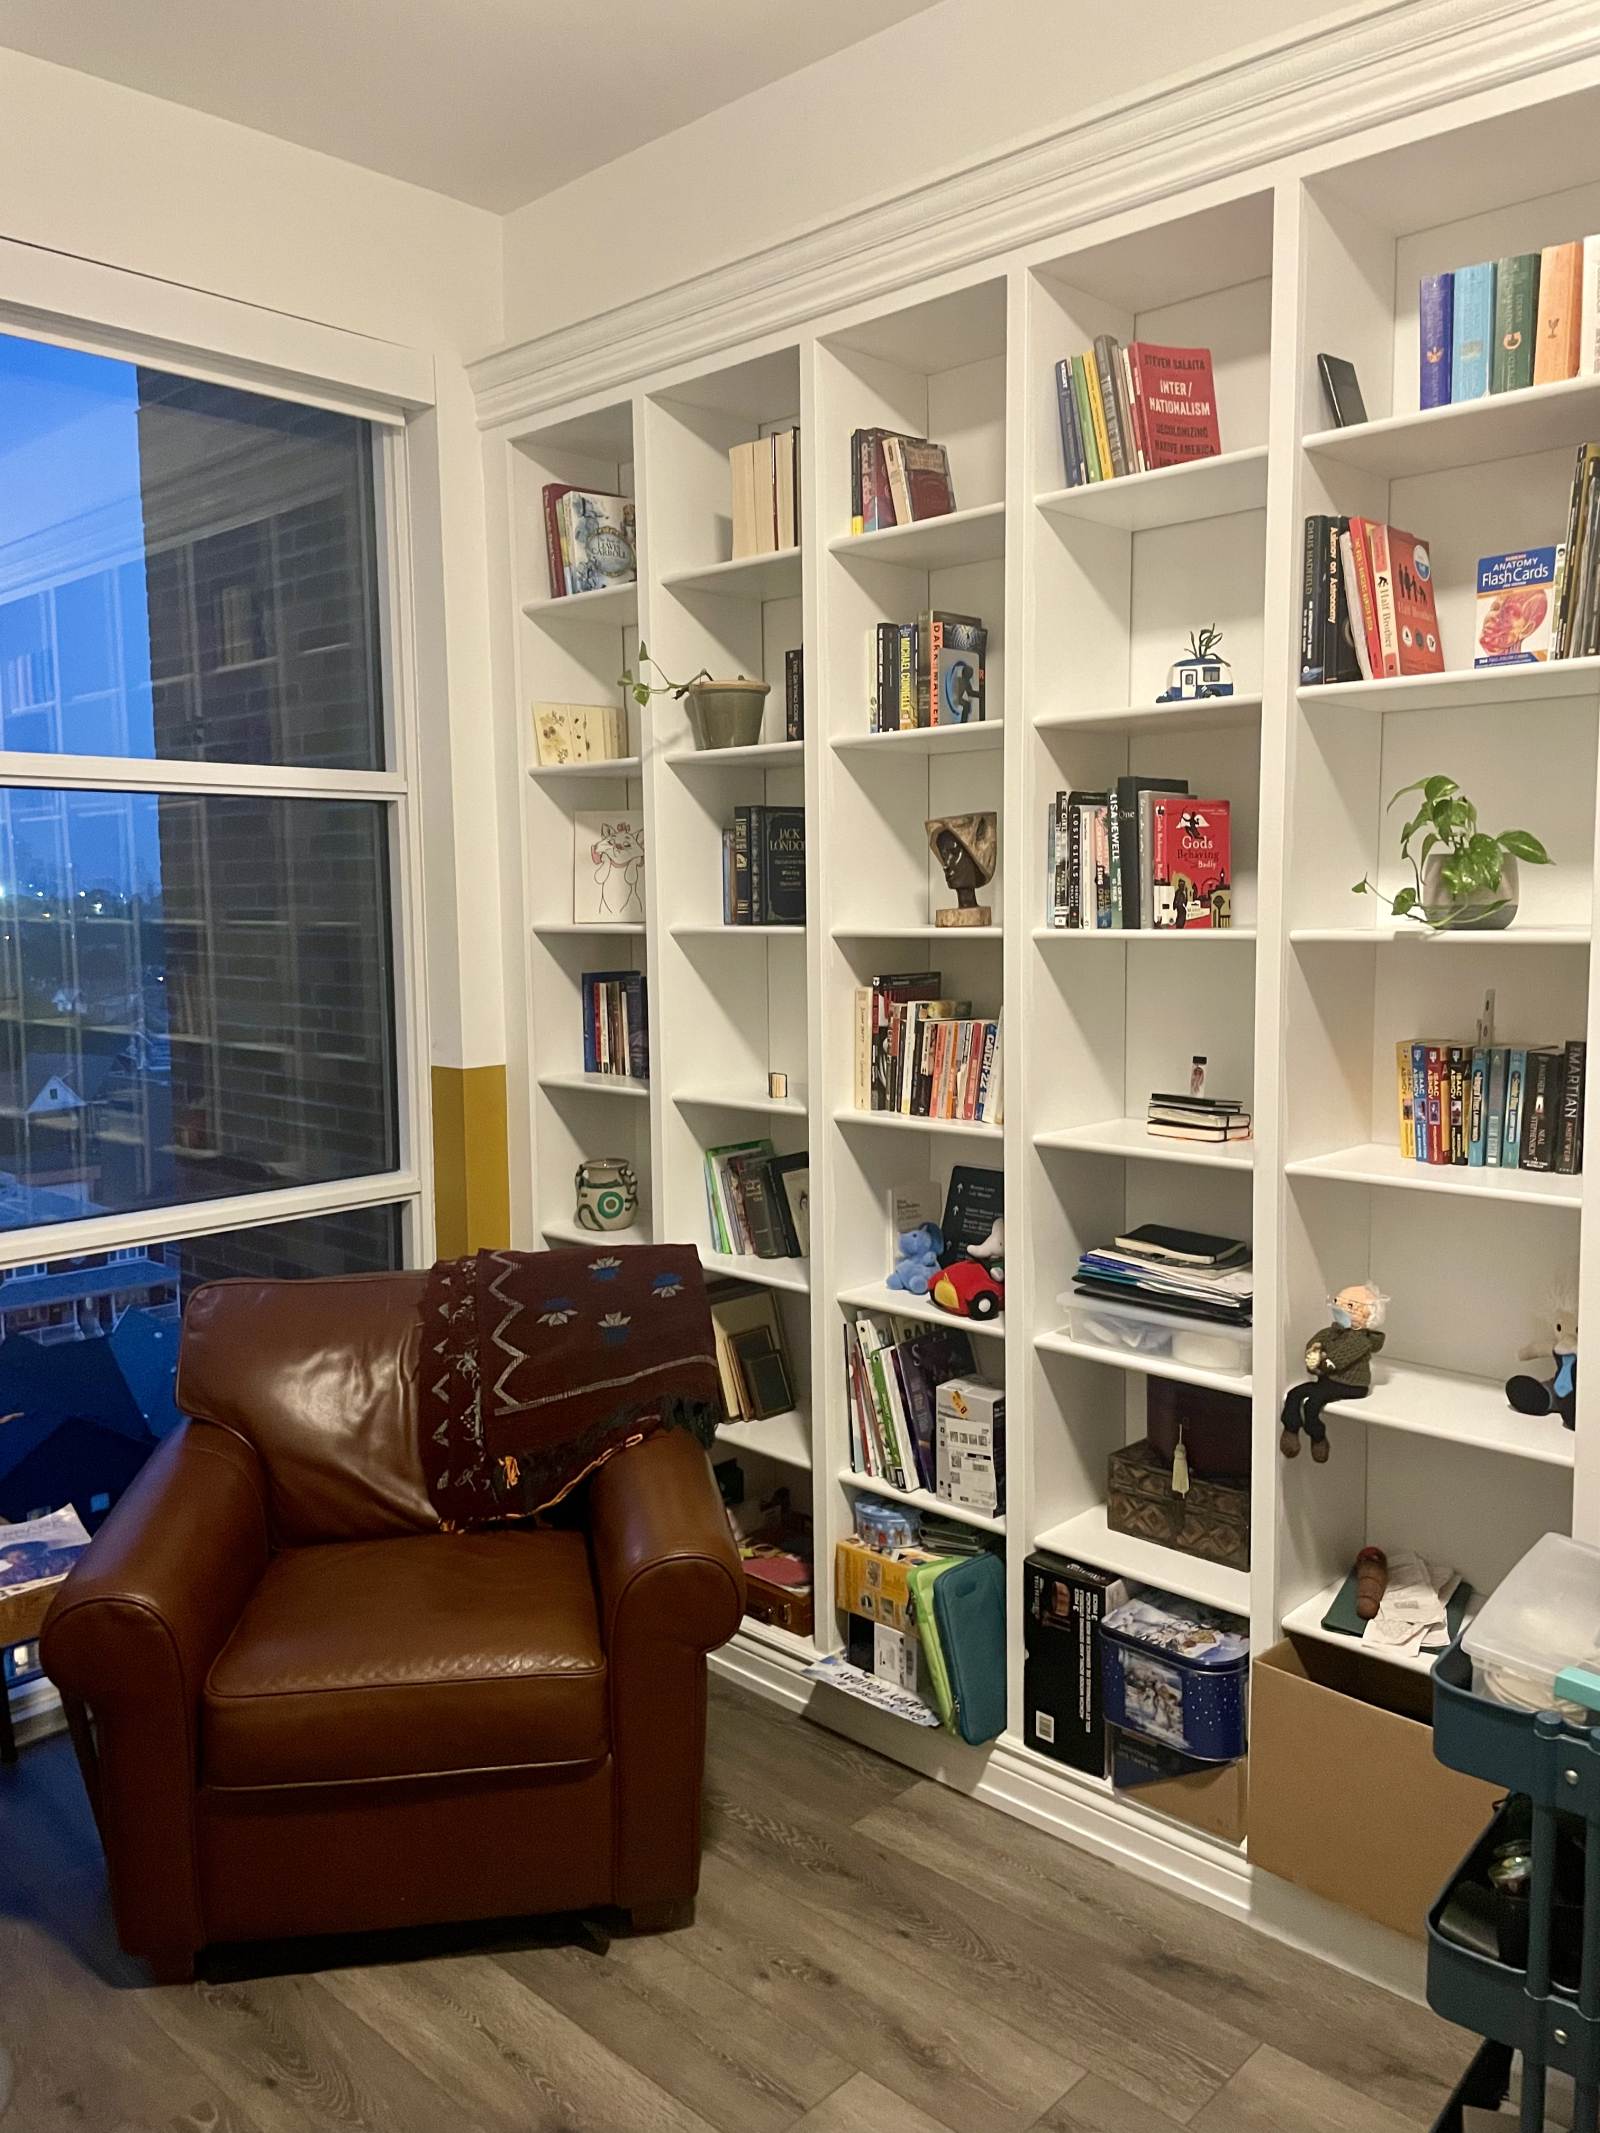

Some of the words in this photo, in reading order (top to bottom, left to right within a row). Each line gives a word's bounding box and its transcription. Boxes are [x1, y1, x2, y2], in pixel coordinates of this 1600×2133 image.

[1144, 354, 1171, 368] STEVEN
[1172, 358, 1205, 370] SALAITA
[1149, 397, 1210, 416] NATIONALISM
[1156, 423, 1208, 438] DECOLONIZING
[1155, 440, 1178, 452] NATIVE
[1179, 444, 1214, 455] AMERICA
[597, 540, 620, 550] LEWIS
[1329, 527, 1339, 559] Asimov
[591, 547, 627, 559] CARROLL
[1330, 561, 1337, 574] on
[1492, 557, 1539, 572] ANATOMY
[1482, 570, 1512, 587] Flash
[1513, 563, 1549, 581] Cards
[1327, 577, 1339, 624] Astronomy
[1380, 588, 1389, 611] Half
[1382, 613, 1393, 649] Brother
[901, 637, 910, 673] MICHAEL
[901, 672, 911, 711] CONNELLY
[1109, 793, 1118, 819] LISA
[779, 828, 800, 840] JACK
[1110, 820, 1120, 863] JEWELL
[1182, 836, 1213, 850] Gods
[1177, 849, 1219, 862] Behaving
[1198, 860, 1216, 869] Badly
[1564, 1051, 1581, 1119] MARTIAN
[1528, 1115, 1537, 1157] STEPHENSON
[1537, 1129, 1545, 1146] NEAL
[1073, 1604, 1080, 1612] 3
[835, 1671, 890, 1695] HOLIDAY
